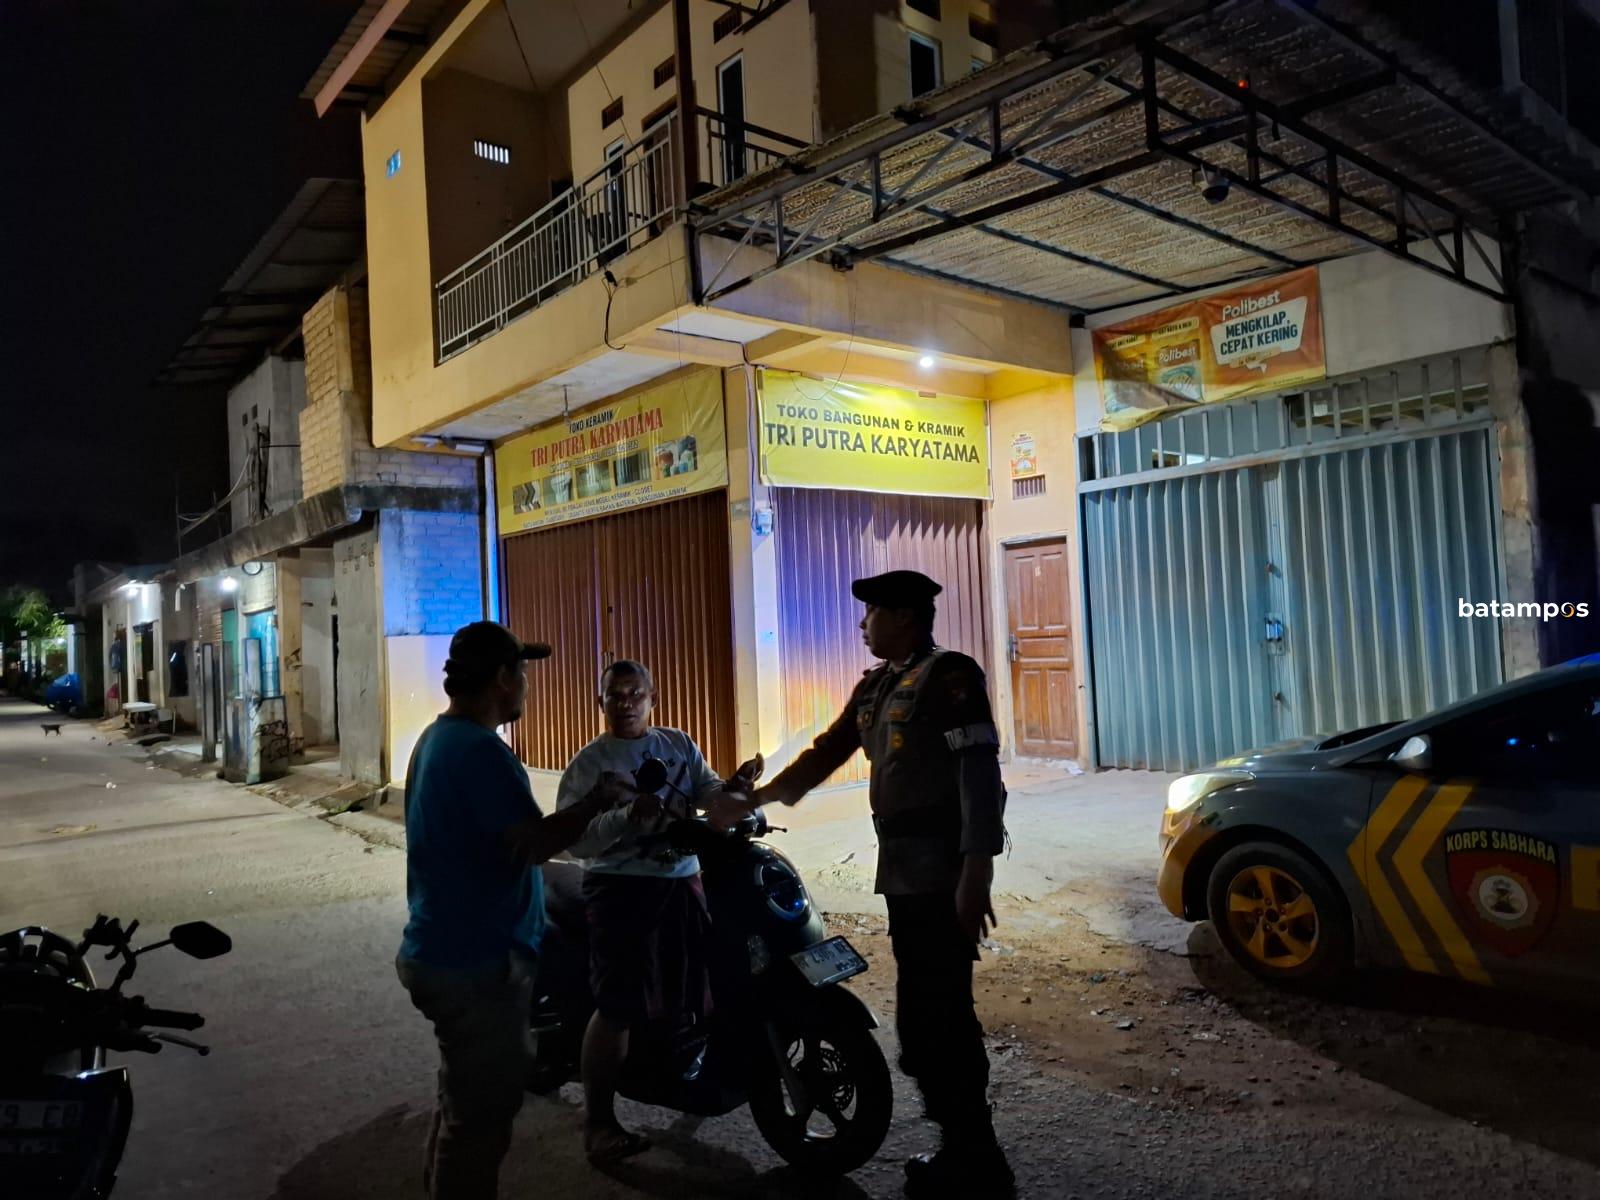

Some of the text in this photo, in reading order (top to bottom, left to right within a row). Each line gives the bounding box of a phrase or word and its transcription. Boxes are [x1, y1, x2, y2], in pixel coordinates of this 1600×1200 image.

[1222, 290, 1281, 321] Polibest
[1159, 346, 1197, 362] Polibest
[1220, 325, 1299, 356] CEPAT KERING
[569, 409, 615, 433] TOKO KERAMIK
[777, 404, 966, 438] TOKO BANGUNAN & KRAMIK
[531, 446, 548, 468] TRI
[551, 433, 586, 462] PUTRA
[589, 407, 664, 450] KARYATAMA
[764, 423, 796, 446] TRI
[802, 427, 867, 453] PUTRA
[871, 434, 980, 463] KARYATAMA
[1446, 831, 1557, 864] KORPS SABHARA
